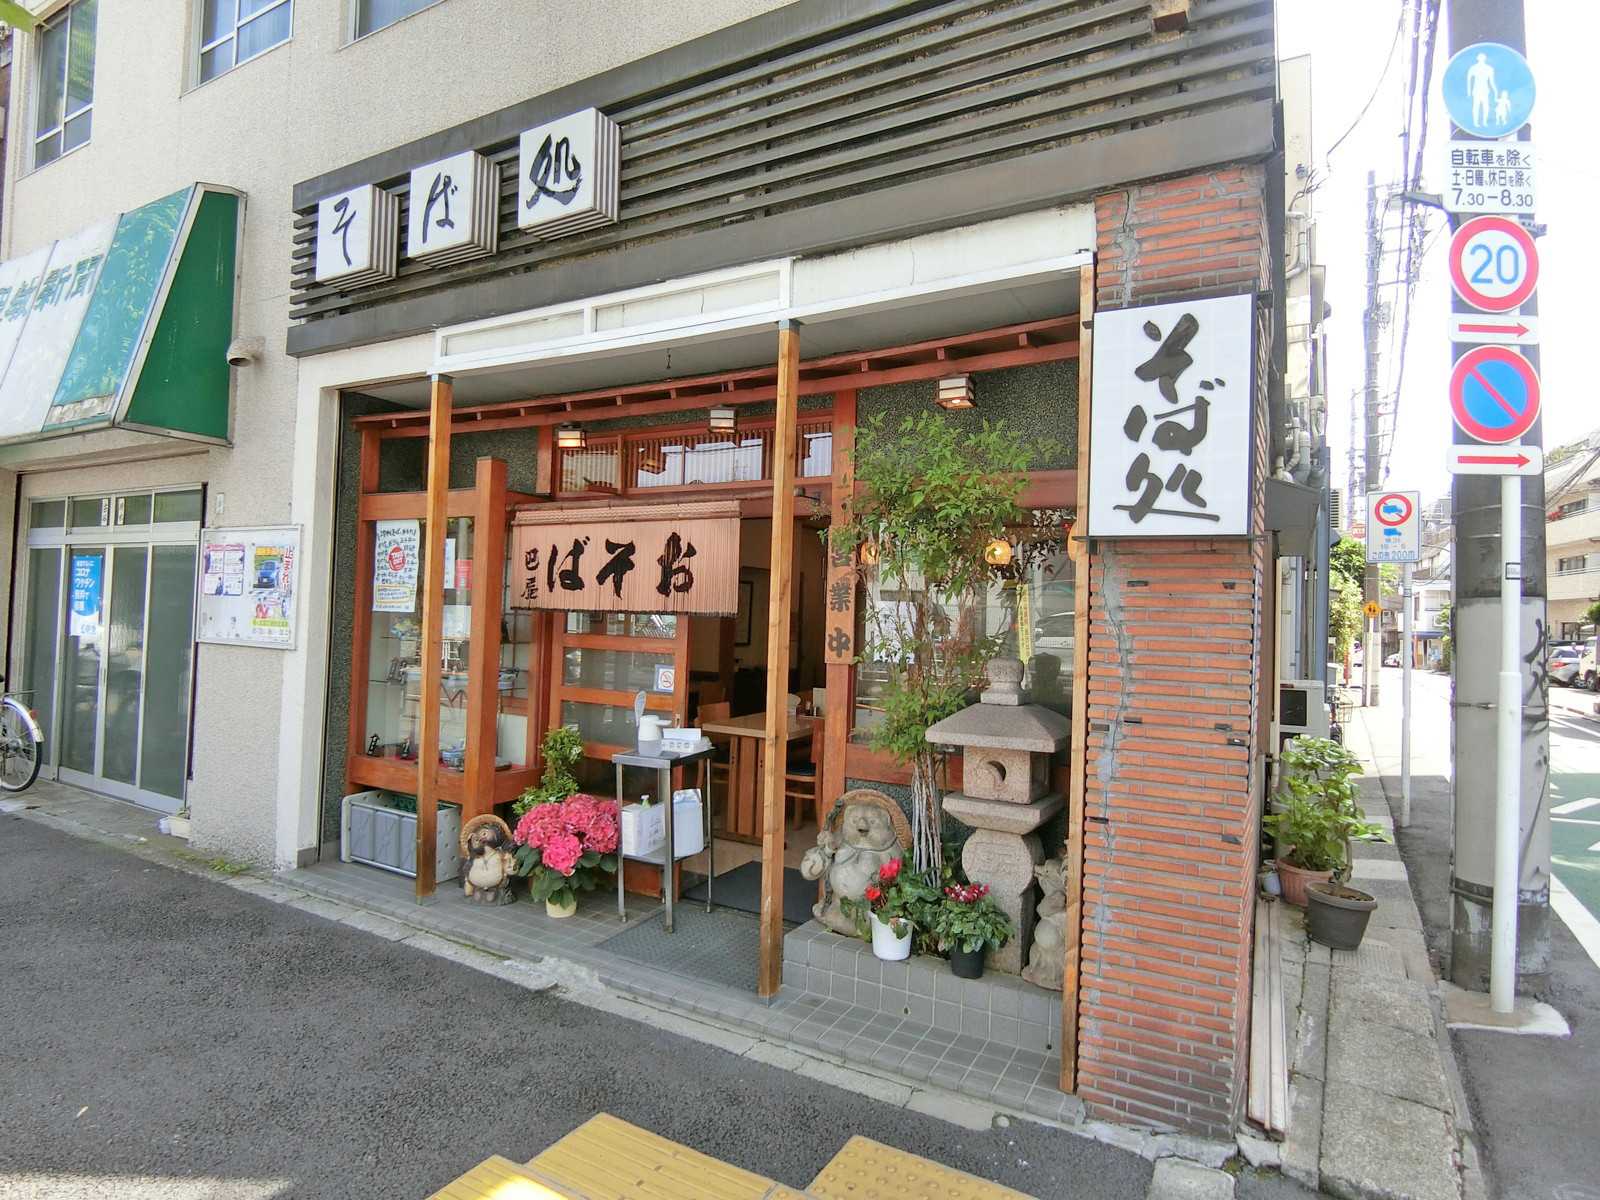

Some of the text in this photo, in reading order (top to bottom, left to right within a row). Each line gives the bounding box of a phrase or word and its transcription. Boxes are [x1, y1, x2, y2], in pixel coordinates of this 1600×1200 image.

[1451, 148, 1531, 167] 自転車を除く
[332, 133, 583, 268] そば処
[1469, 243, 1519, 284] 20
[1112, 312, 1226, 524] そば処
[391, 550, 404, 560] TAKE
[393, 557, 403, 565] OUT
[75, 567, 91, 577] コロナ
[547, 531, 697, 600] おそば
[75, 578, 95, 589] ワクチン
